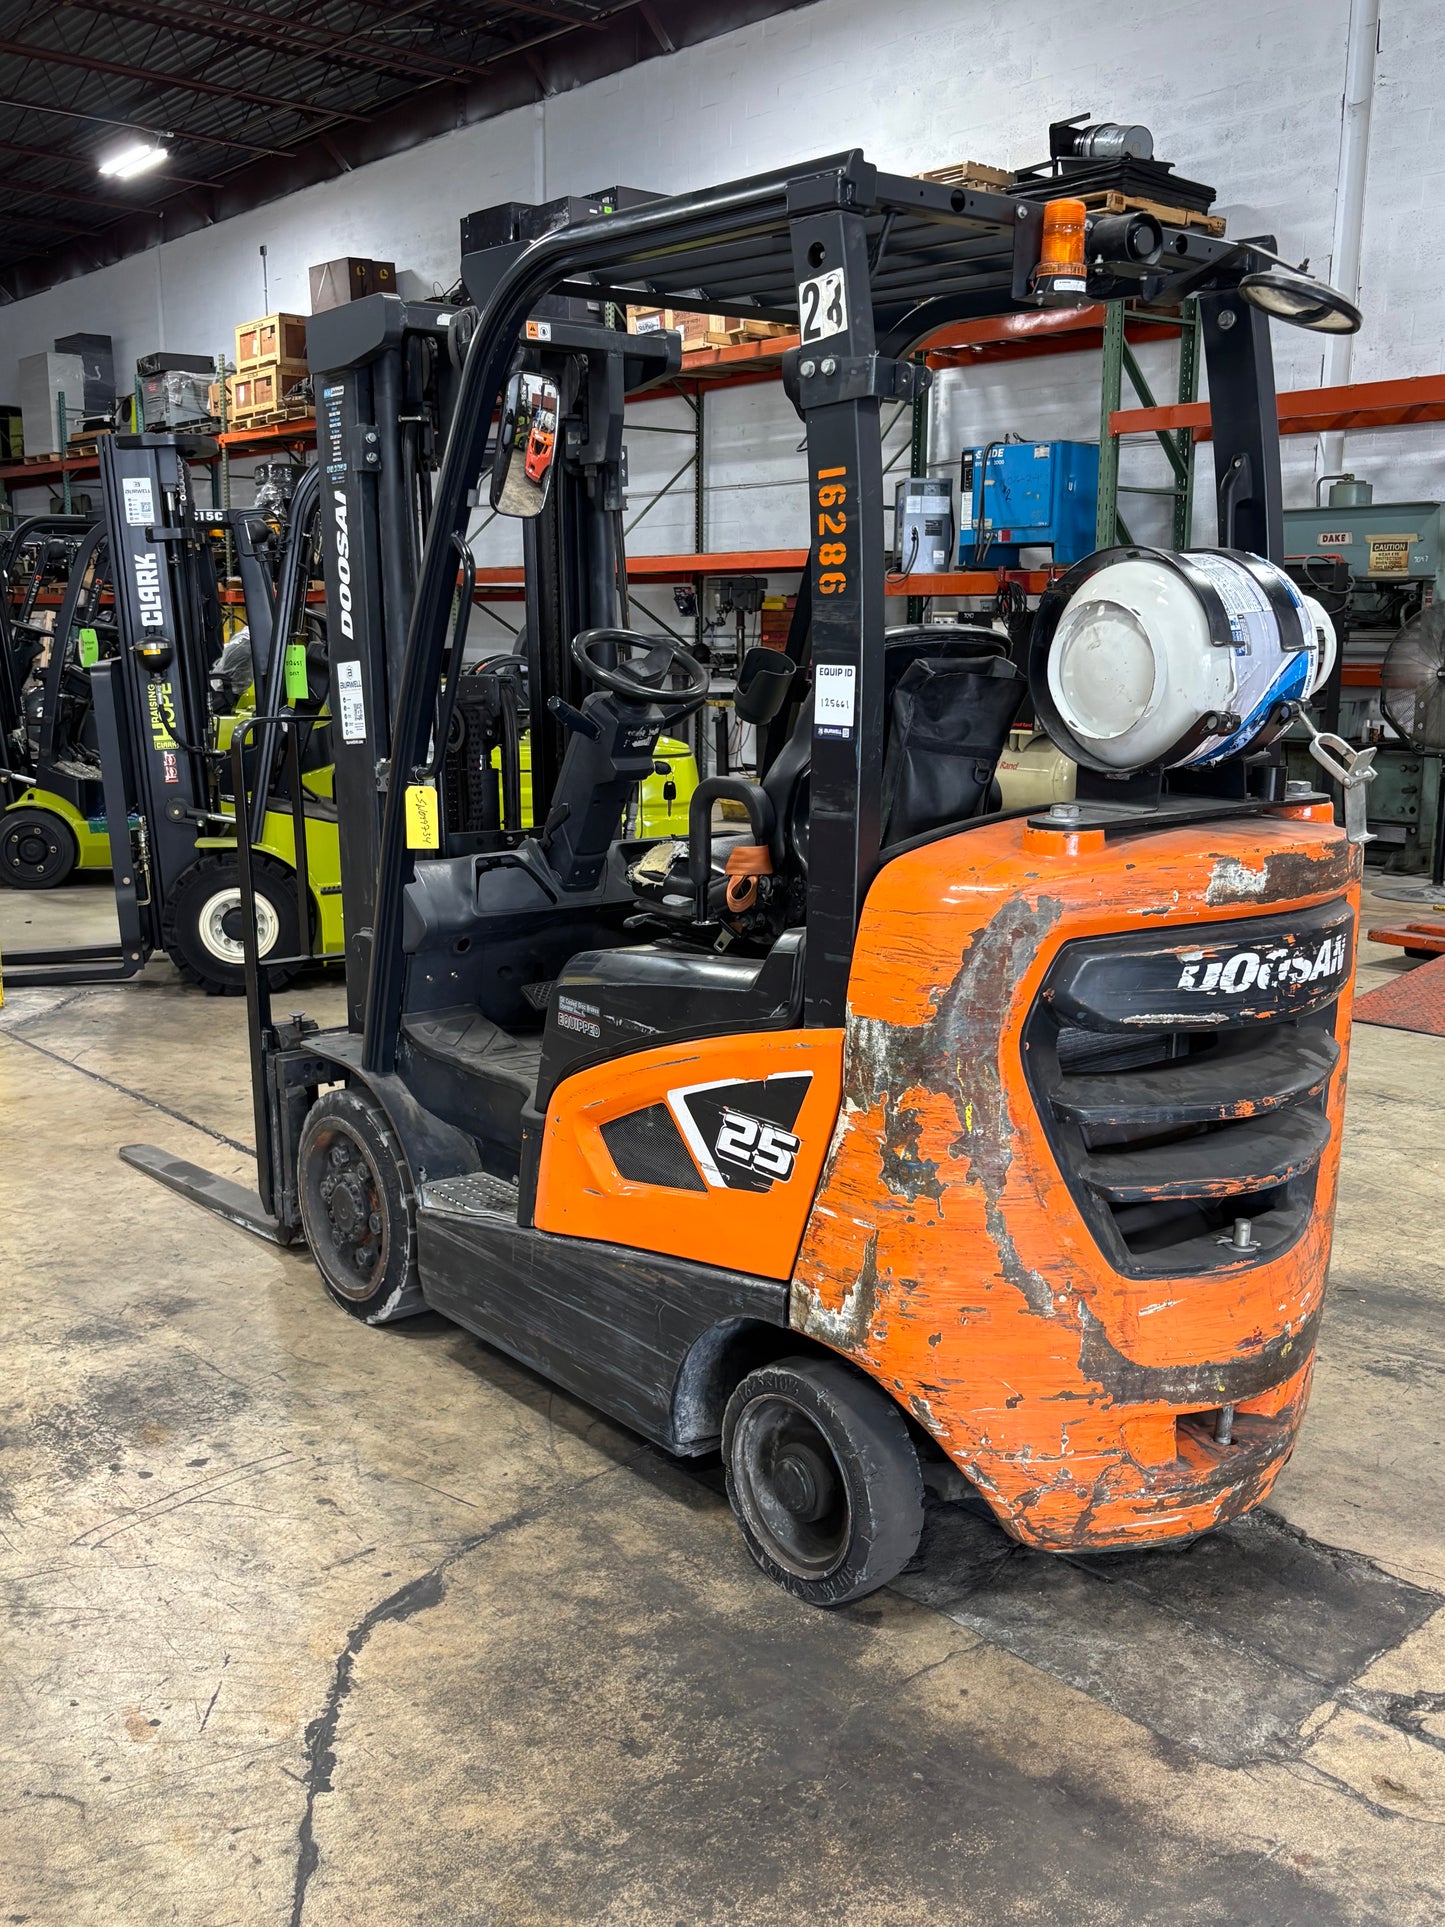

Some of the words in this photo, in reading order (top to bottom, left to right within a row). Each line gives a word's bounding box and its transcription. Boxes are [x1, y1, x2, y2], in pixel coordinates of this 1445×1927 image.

[818, 466, 847, 595] 16286
[1322, 533, 1347, 543] DAKE
[1373, 543, 1406, 551] CAUTION
[134, 553, 164, 627] CLARK
[819, 667, 843, 677] EQUIP
[844, 668, 853, 677] ID
[147, 684, 160, 723] RAISING
[821, 698, 849, 709] 125661
[558, 1012, 600, 1037] EQUIPPED
[714, 1112, 803, 1183] 25
